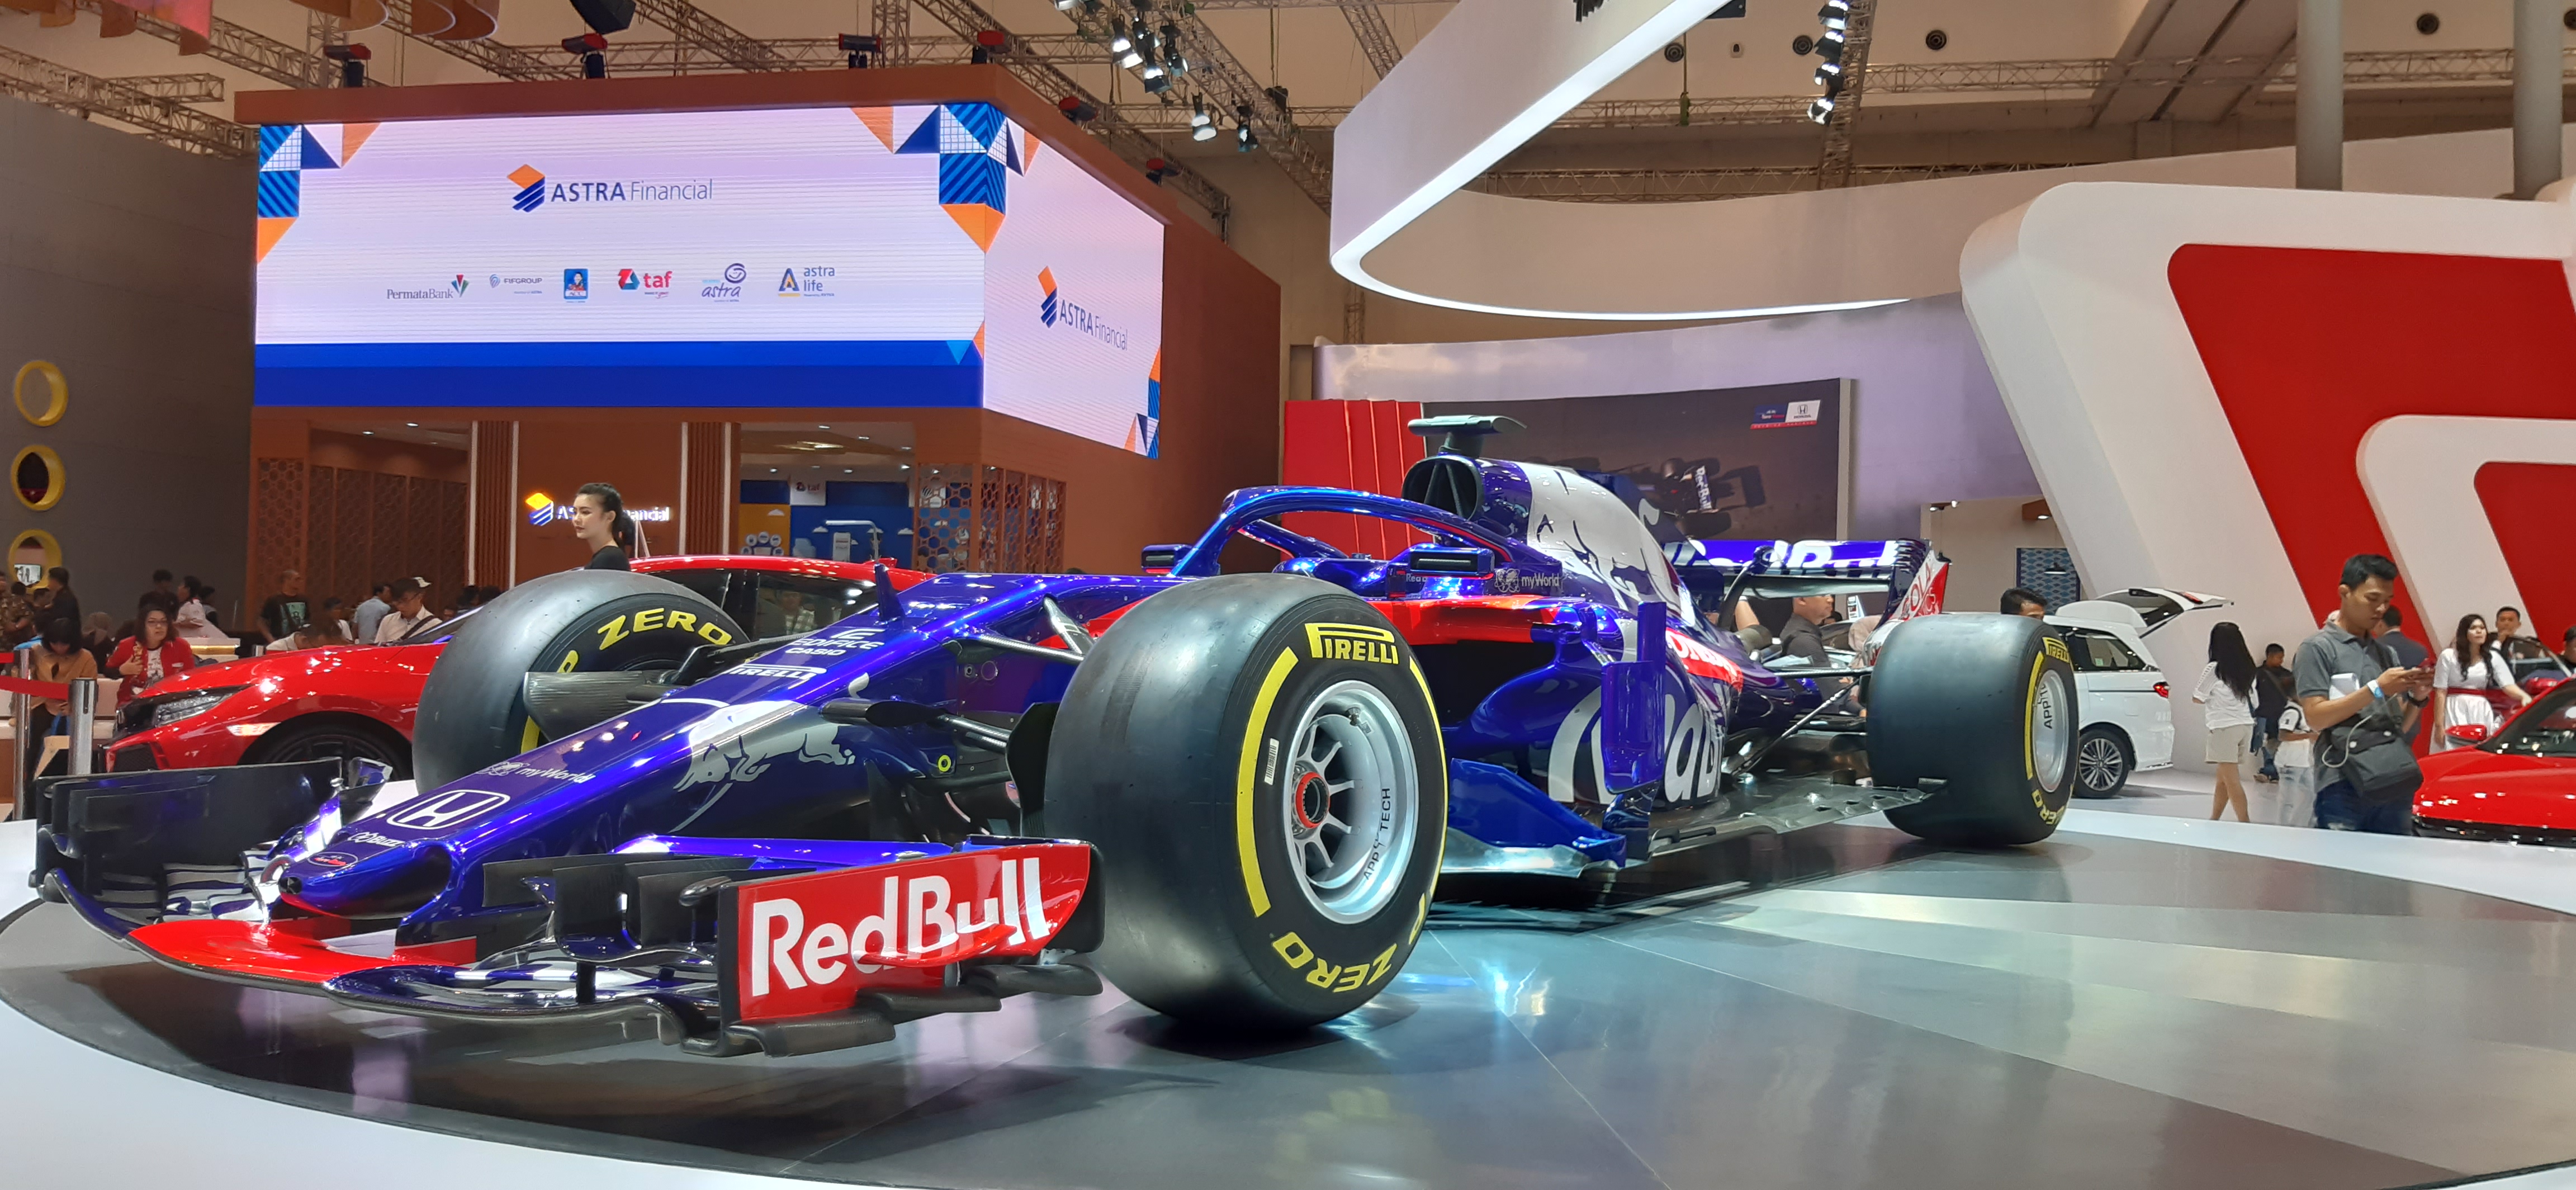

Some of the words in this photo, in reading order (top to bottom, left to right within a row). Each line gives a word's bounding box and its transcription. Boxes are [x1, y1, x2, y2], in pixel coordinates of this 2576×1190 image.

[551, 182, 626, 202] ASTRA
[631, 179, 713, 201] Financial
[643, 271, 673, 288] taf
[804, 266, 835, 277] astra
[702, 282, 741, 298] astra
[804, 280, 823, 291] life
[387, 289, 453, 299] PermataBank
[1059, 299, 1093, 336] ASTRA
[1095, 315, 1128, 351] Financial
[1521, 573, 1560, 588] myWorld
[598, 607, 732, 650] ZERO
[792, 638, 885, 649] EDIFICE
[1304, 622, 1399, 665] PIRELLI
[2042, 636, 2071, 663] PIRELLI
[515, 768, 596, 783] myWorld
[1272, 931, 1398, 993] ZERO
